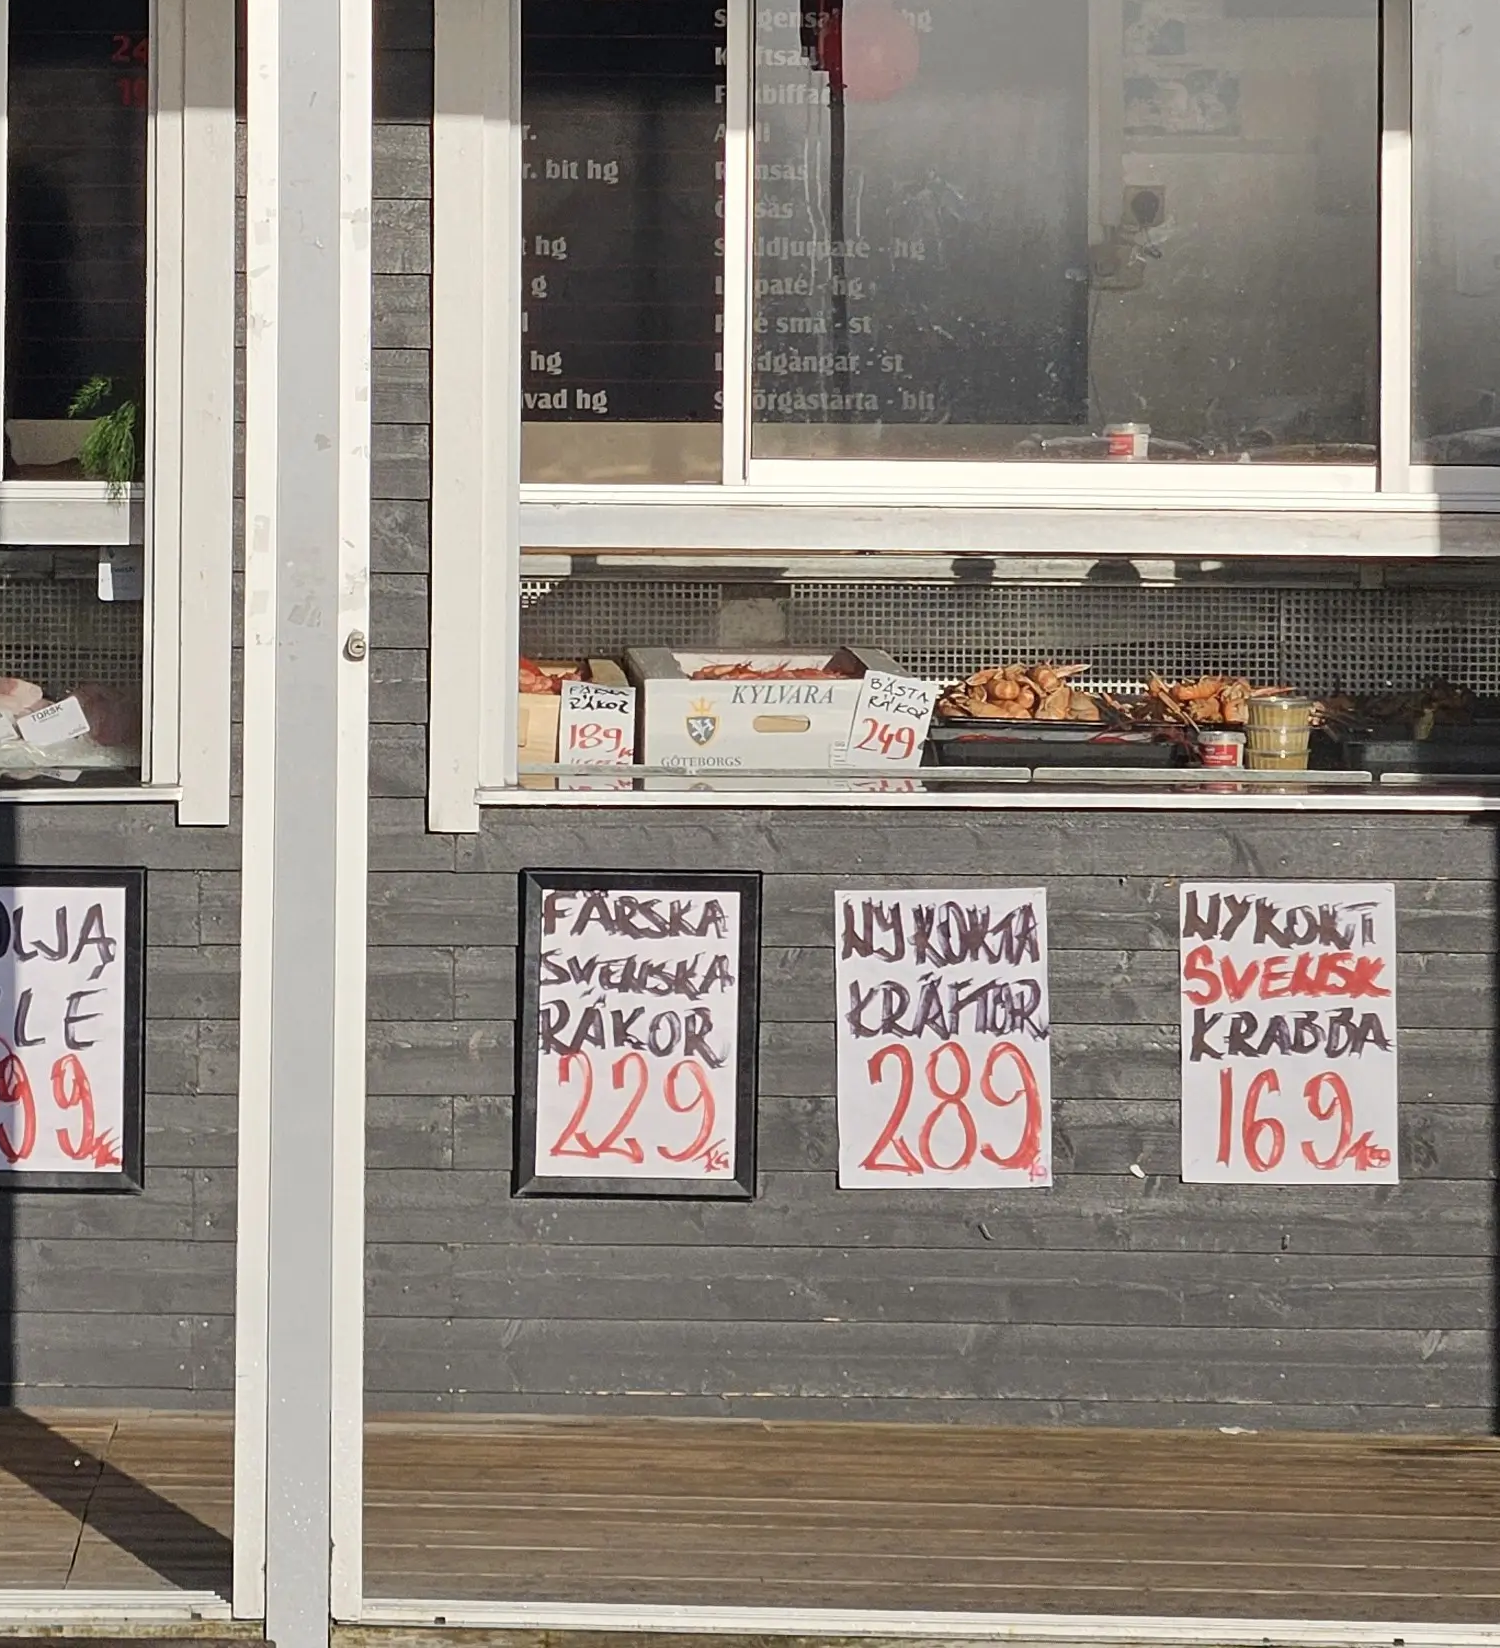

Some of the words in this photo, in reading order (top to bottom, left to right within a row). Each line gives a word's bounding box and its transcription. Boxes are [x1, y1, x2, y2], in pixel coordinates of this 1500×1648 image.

[545, 158, 579, 180] bit
[587, 158, 619, 184] hg
[535, 235, 567, 261] hg
[894, 237, 927, 261] hg
[832, 275, 863, 299] hg
[775, 310, 828, 334] små
[848, 315, 873, 334] st
[530, 350, 562, 375] hg
[880, 352, 905, 373] st
[576, 388, 608, 414] hg
[902, 389, 936, 411] bit
[731, 684, 834, 705] KYLVARA
[31, 703, 64, 723] TORSK
[569, 722, 623, 753] 189
[853, 717, 916, 760] 249
[660, 755, 742, 767] GÖTEBORGS
[542, 889, 729, 941] FÄRSKA
[540, 947, 735, 1000] SVENSKA
[1181, 943, 1393, 1006] SVENSK
[844, 972, 1051, 1041] KRÄFTOR
[537, 987, 729, 1069] RÄKOR
[1189, 1006, 1395, 1062] KRABBA
[549, 1050, 716, 1165] 229
[859, 1040, 1043, 1175] 289
[1215, 1066, 1356, 1174] 169
